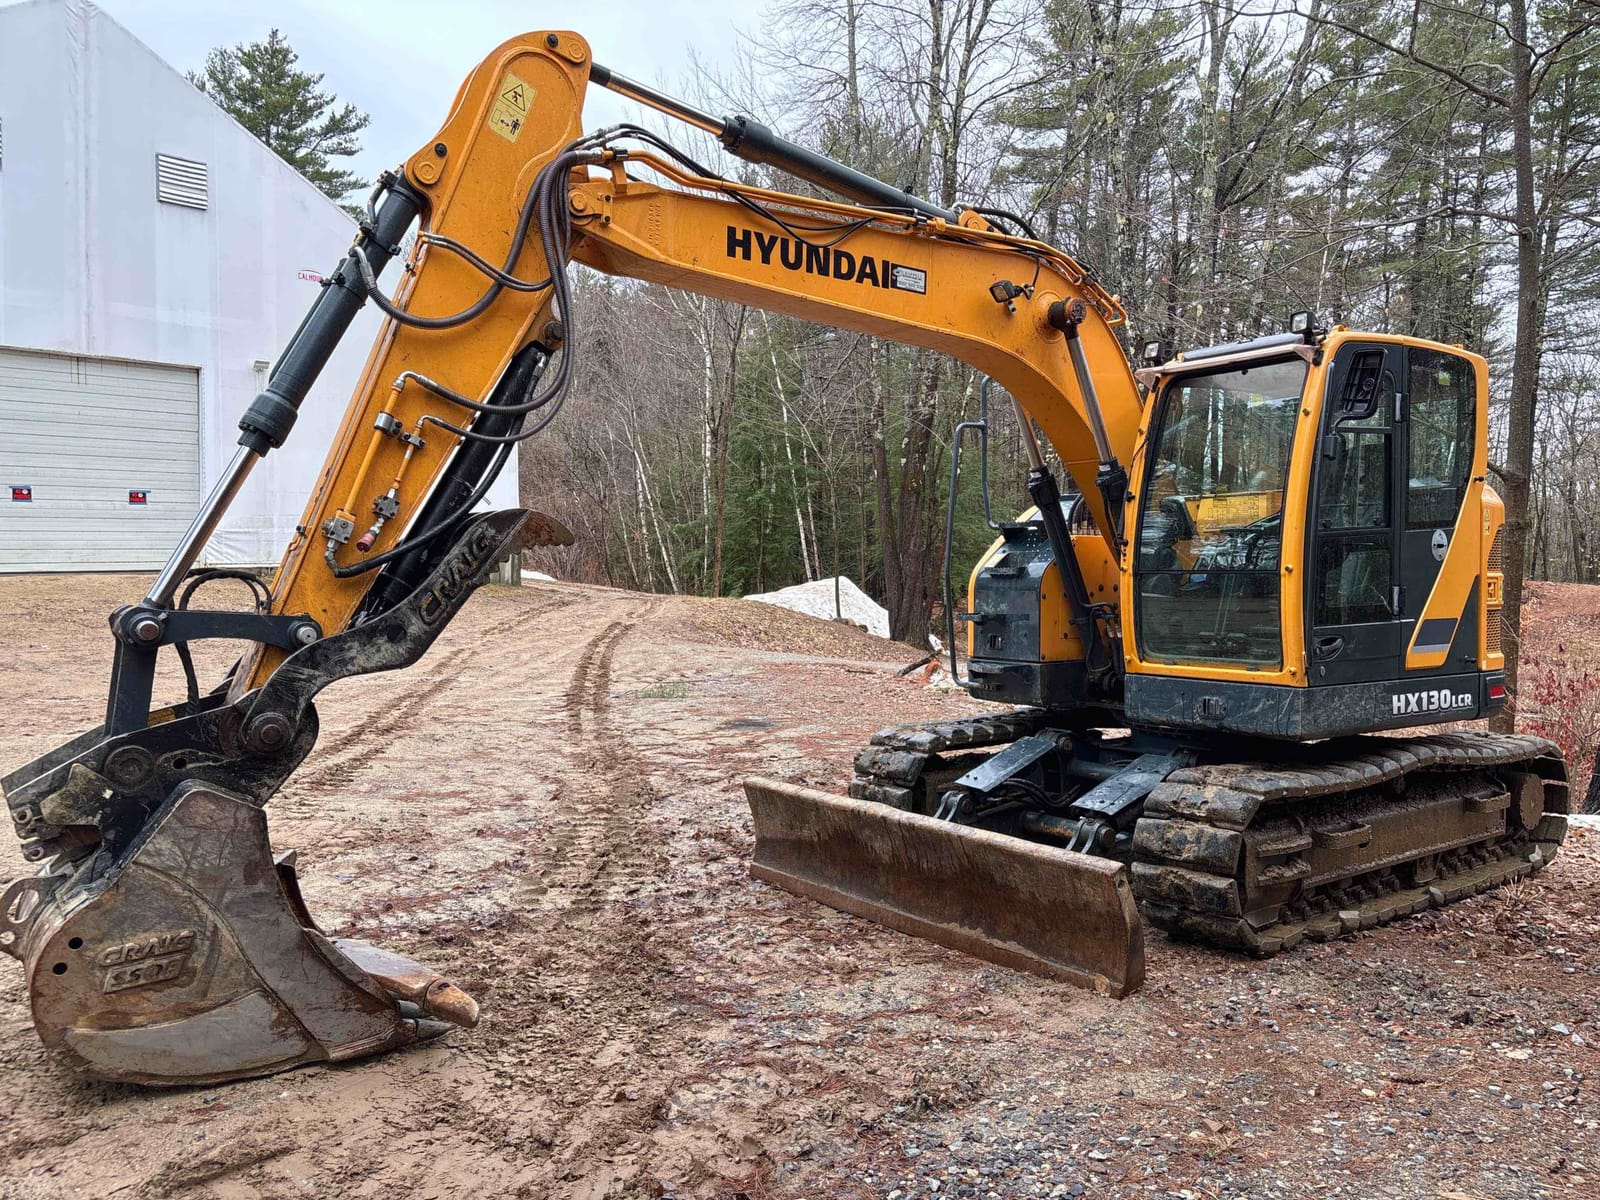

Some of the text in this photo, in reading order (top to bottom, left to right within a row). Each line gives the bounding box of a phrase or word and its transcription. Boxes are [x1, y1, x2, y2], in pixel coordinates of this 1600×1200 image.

[726, 225, 890, 290] HYUNDAI
[420, 527, 490, 625] CRAIG
[99, 930, 197, 967] CRAIG
